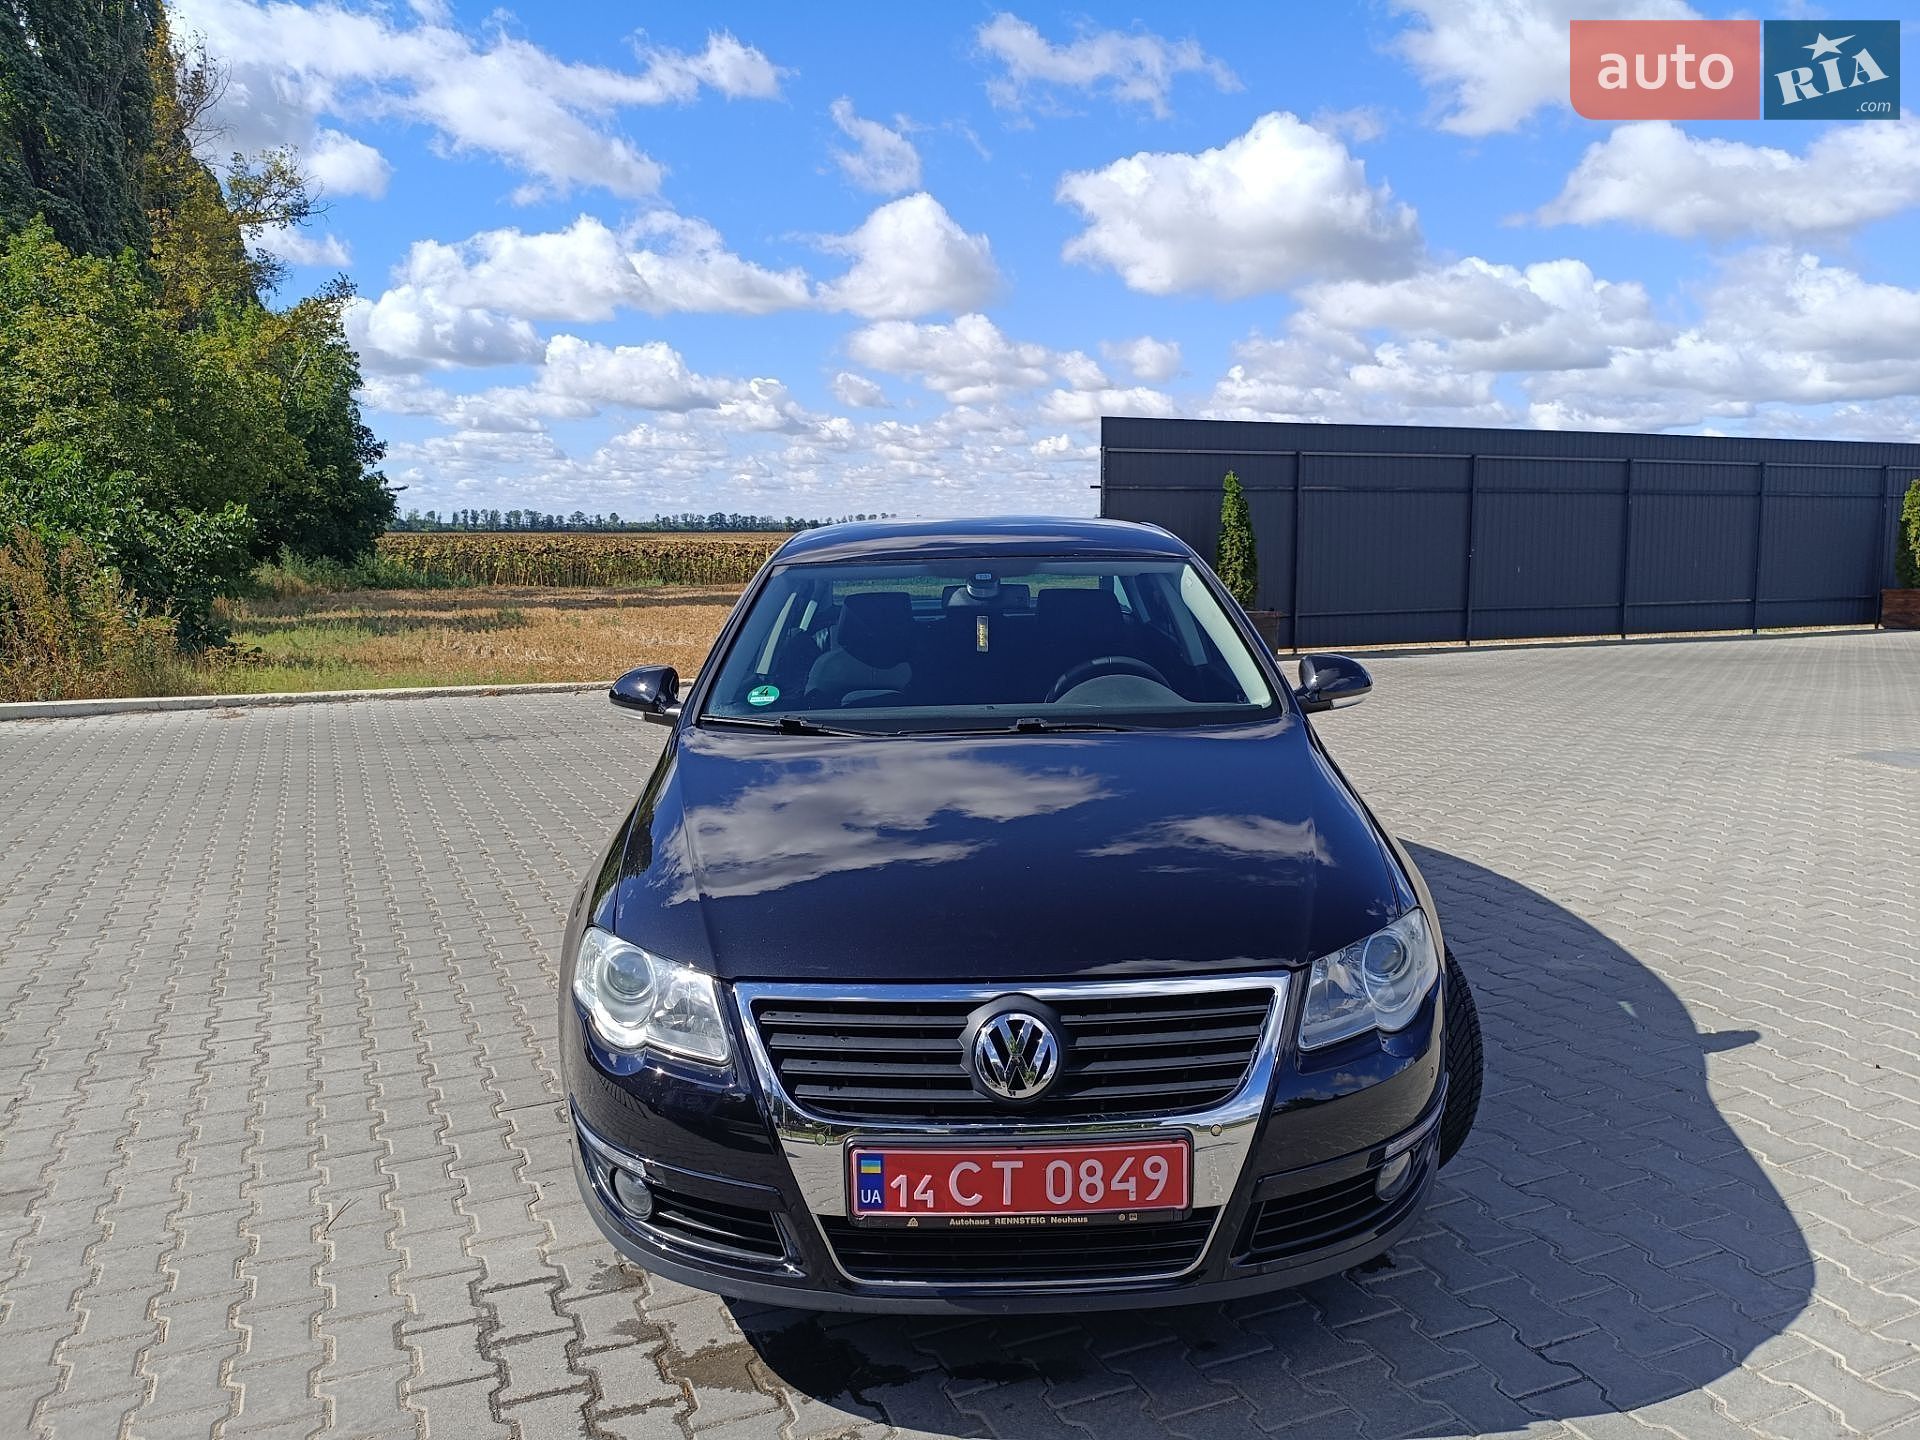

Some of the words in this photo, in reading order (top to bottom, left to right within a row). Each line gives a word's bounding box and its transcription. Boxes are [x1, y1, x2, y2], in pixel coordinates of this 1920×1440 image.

[760, 686, 769, 697] 4
[890, 1174, 934, 1208] 14
[948, 1160, 1024, 1207] CT
[1045, 1155, 1169, 1205] 0849
[861, 1189, 882, 1204] UA
[949, 1217, 990, 1226] Autohaus
[994, 1216, 1046, 1225] RENNSTEIG
[1050, 1215, 1088, 1224] Neuhaus
